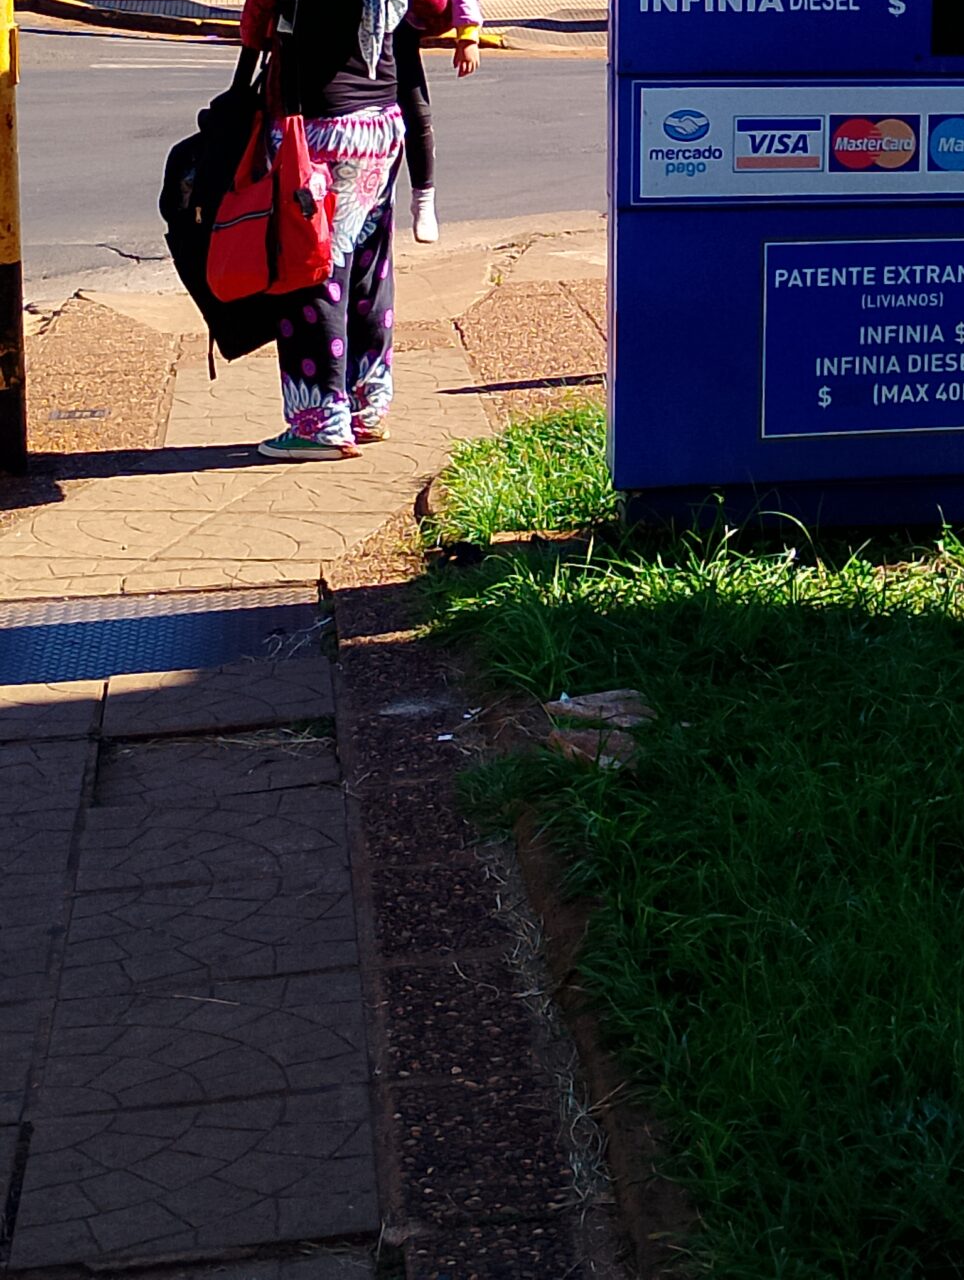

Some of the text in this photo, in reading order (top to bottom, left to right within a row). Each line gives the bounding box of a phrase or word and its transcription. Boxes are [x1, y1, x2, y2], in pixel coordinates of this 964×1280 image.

[649, 145, 723, 161] mercado
[747, 133, 809, 154] VISA
[834, 134, 915, 153] MasterCard
[665, 160, 706, 177] pago
[774, 266, 876, 288] PATENTE
[861, 292, 944, 310] (LIVIANOS)
[859, 324, 945, 345] INFINIA
[815, 354, 901, 377] INFINIA
[818, 385, 832, 408] $
[873, 383, 929, 406] (MAX
